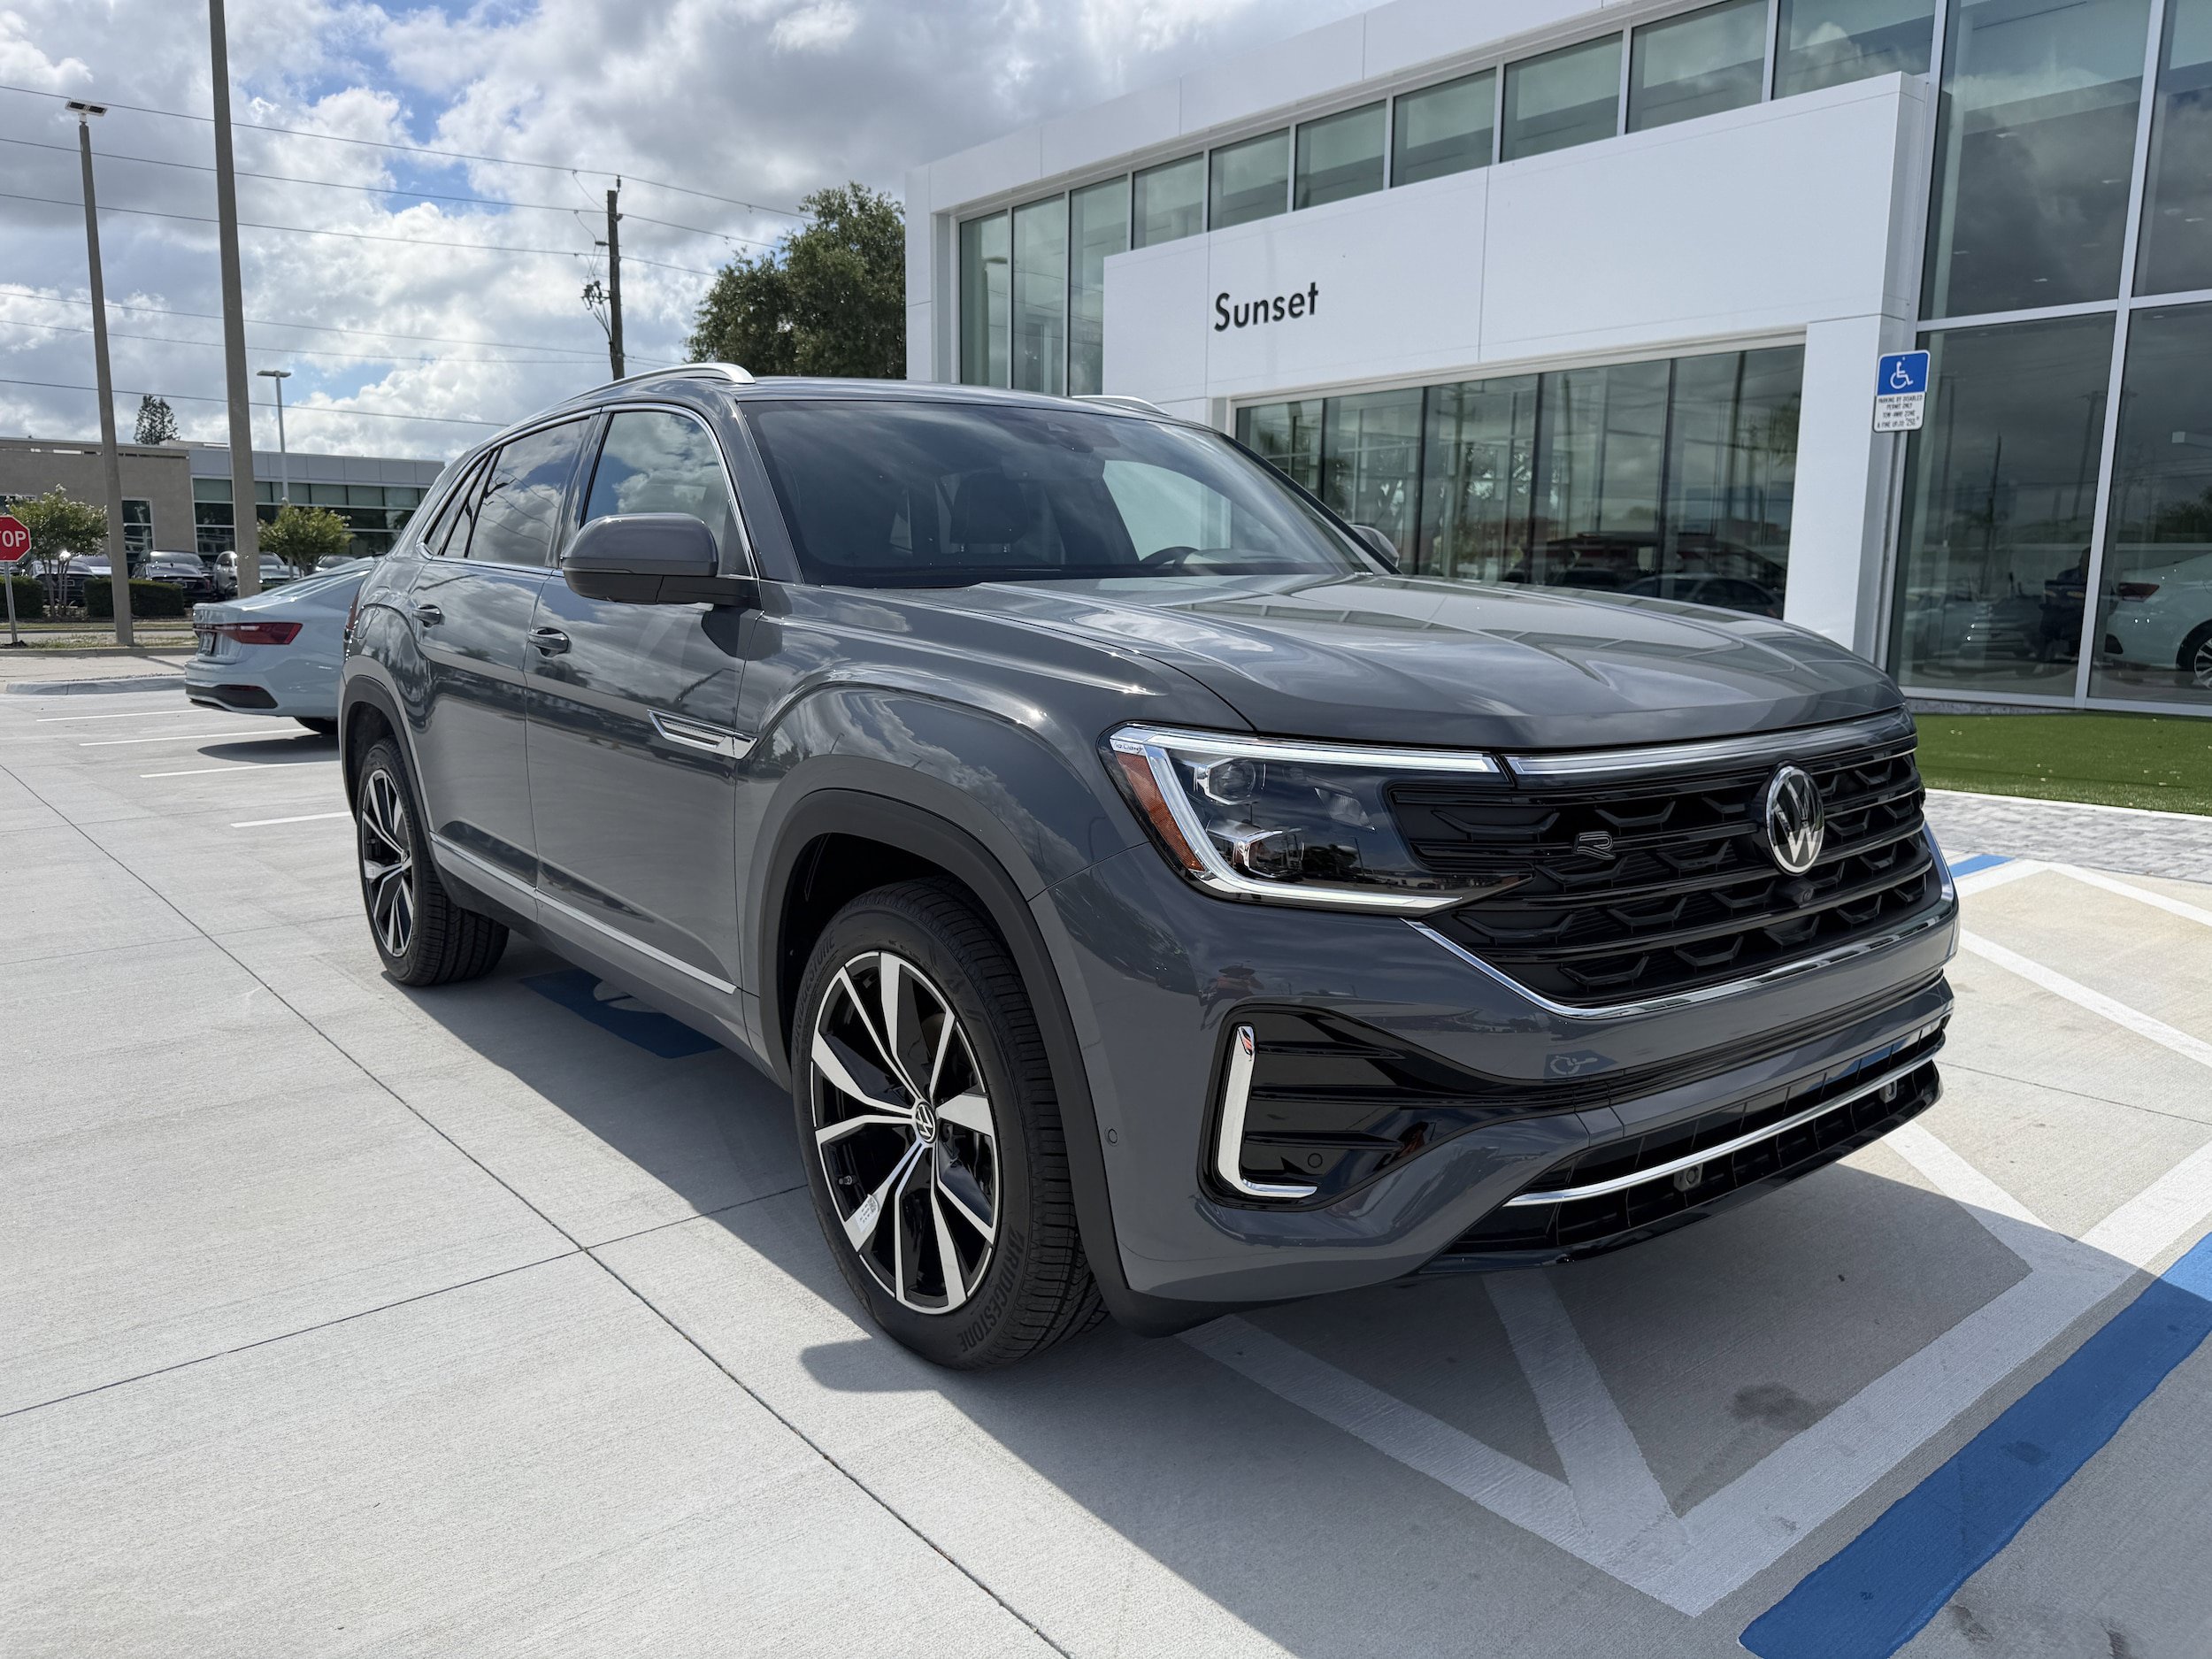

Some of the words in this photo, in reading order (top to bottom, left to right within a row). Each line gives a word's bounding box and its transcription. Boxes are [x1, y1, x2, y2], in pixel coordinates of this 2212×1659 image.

[1214, 281, 1318, 332] Sunset
[0, 530, 27, 548] OP
[957, 1225, 1025, 1352] BRIDGESTONE
